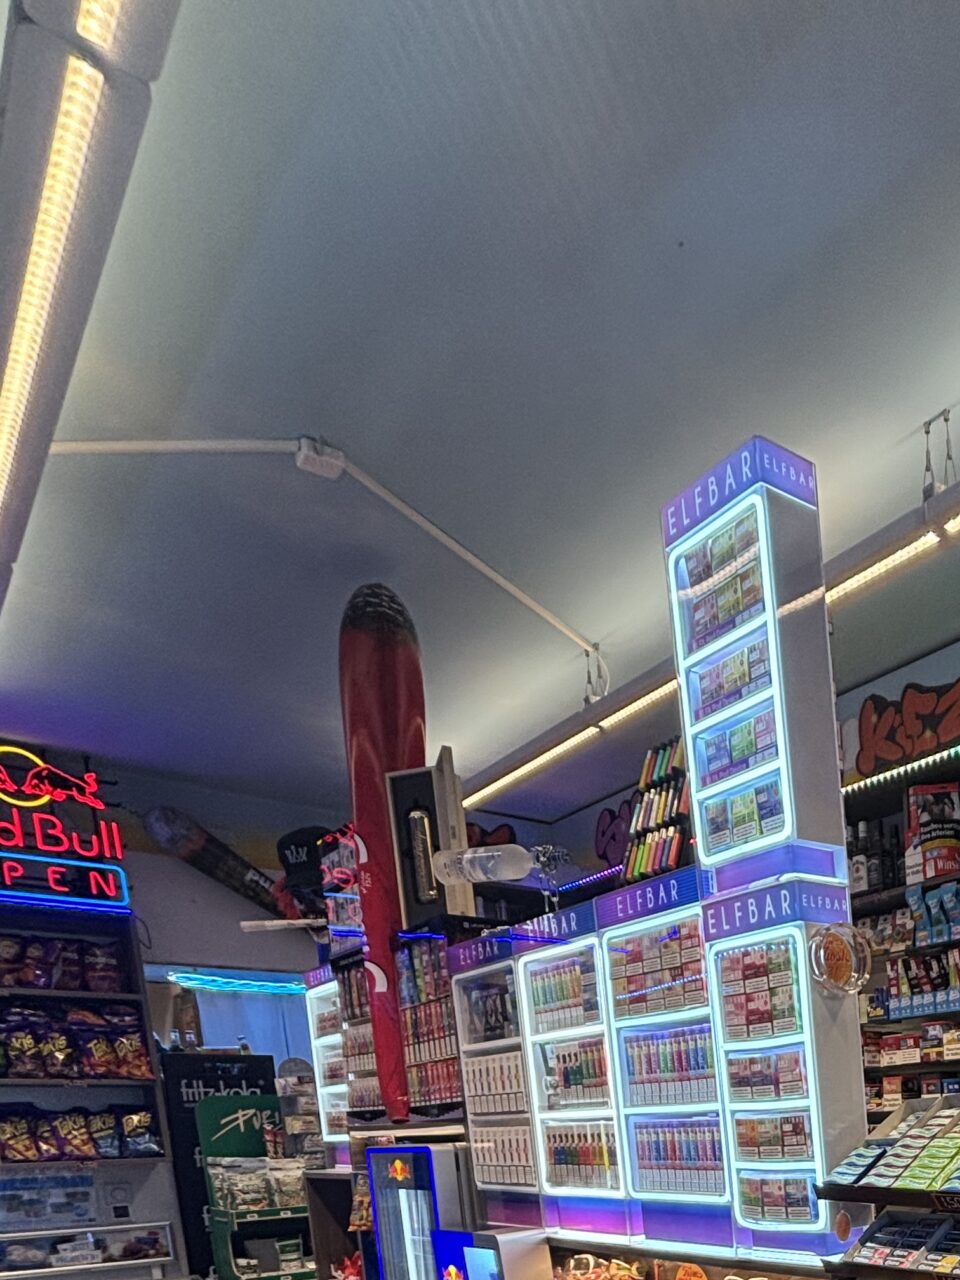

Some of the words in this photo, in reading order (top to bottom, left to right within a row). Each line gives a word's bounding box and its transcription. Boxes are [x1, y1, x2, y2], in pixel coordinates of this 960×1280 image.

[763, 453, 815, 490] ELFBAR
[668, 449, 753, 537] ELFBAR
[32, 812, 124, 860] Bull
[616, 879, 680, 917] ELFBAR
[708, 888, 793, 935] ELFBAR
[802, 892, 848, 914] ELFBAR
[459, 936, 501, 966] ELFBAR
